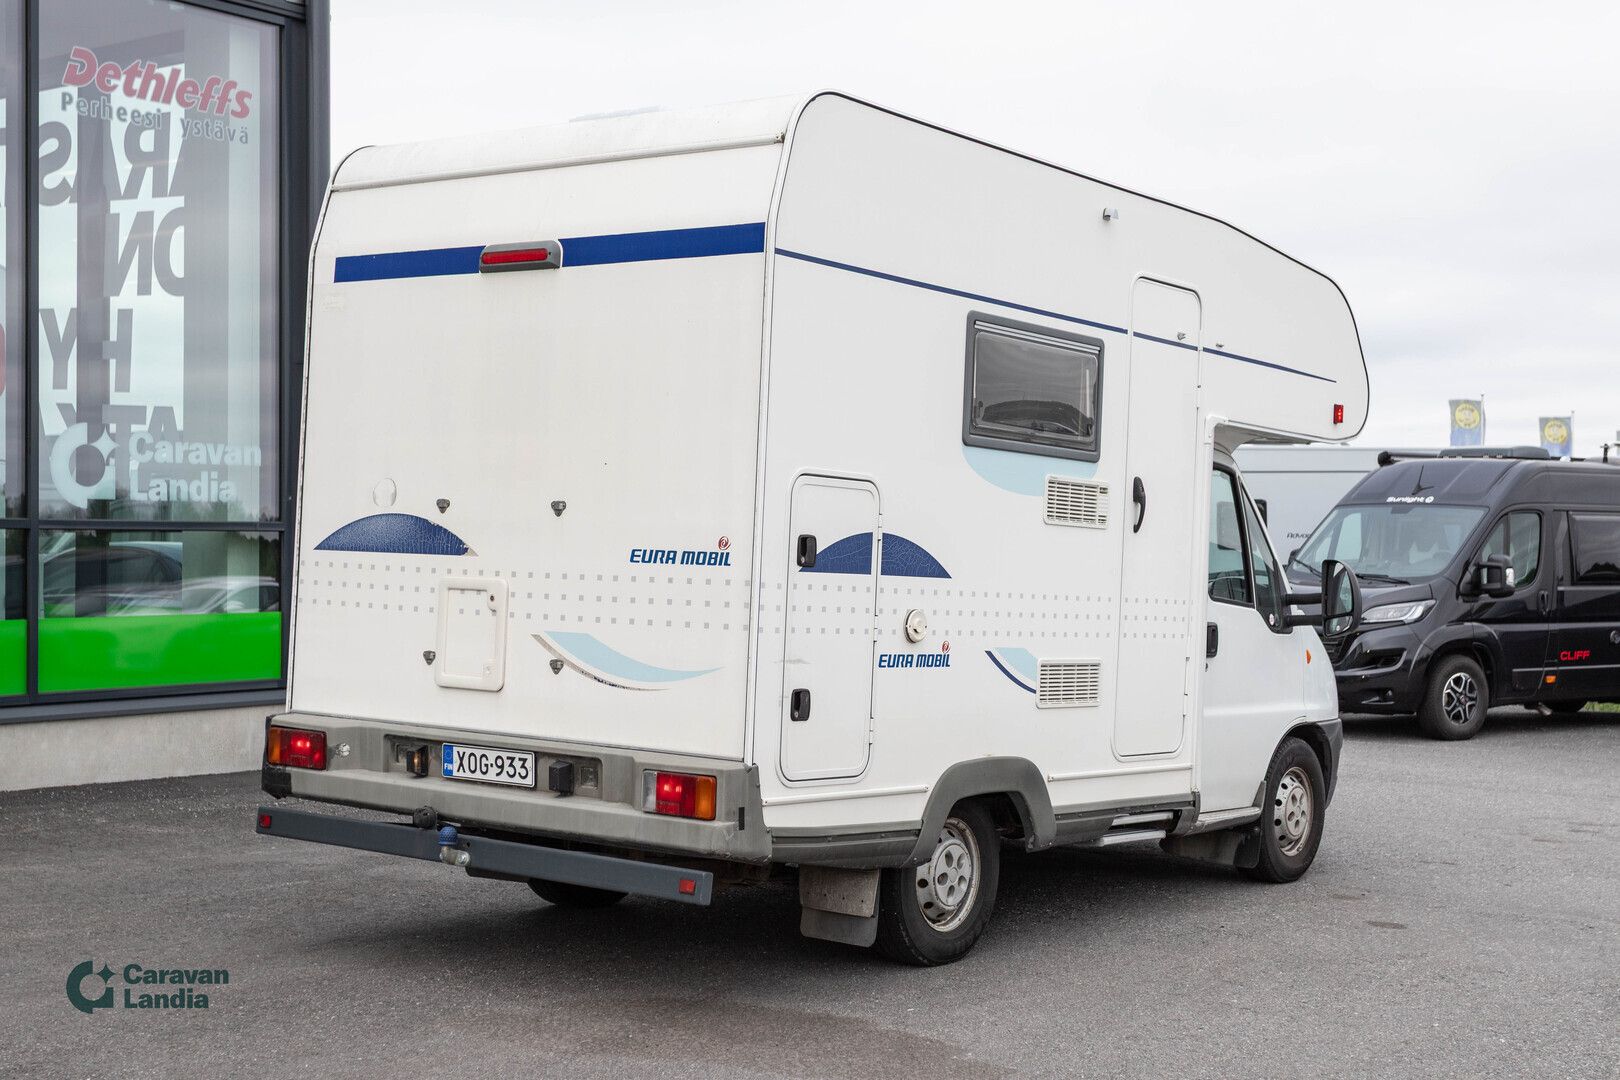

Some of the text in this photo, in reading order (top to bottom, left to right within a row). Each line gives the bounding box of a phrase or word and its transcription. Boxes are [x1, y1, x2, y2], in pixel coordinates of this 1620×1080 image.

[61, 46, 253, 119] Dethleffs
[60, 91, 249, 145] Perheesi ystävä
[129, 430, 262, 467] Caravan
[129, 470, 238, 503] Landia
[629, 548, 731, 567] EURA MOBIL
[878, 653, 951, 668] EURA MOBIL
[1560, 650, 1591, 661] CLIFF
[456, 750, 529, 780] XOG-933
